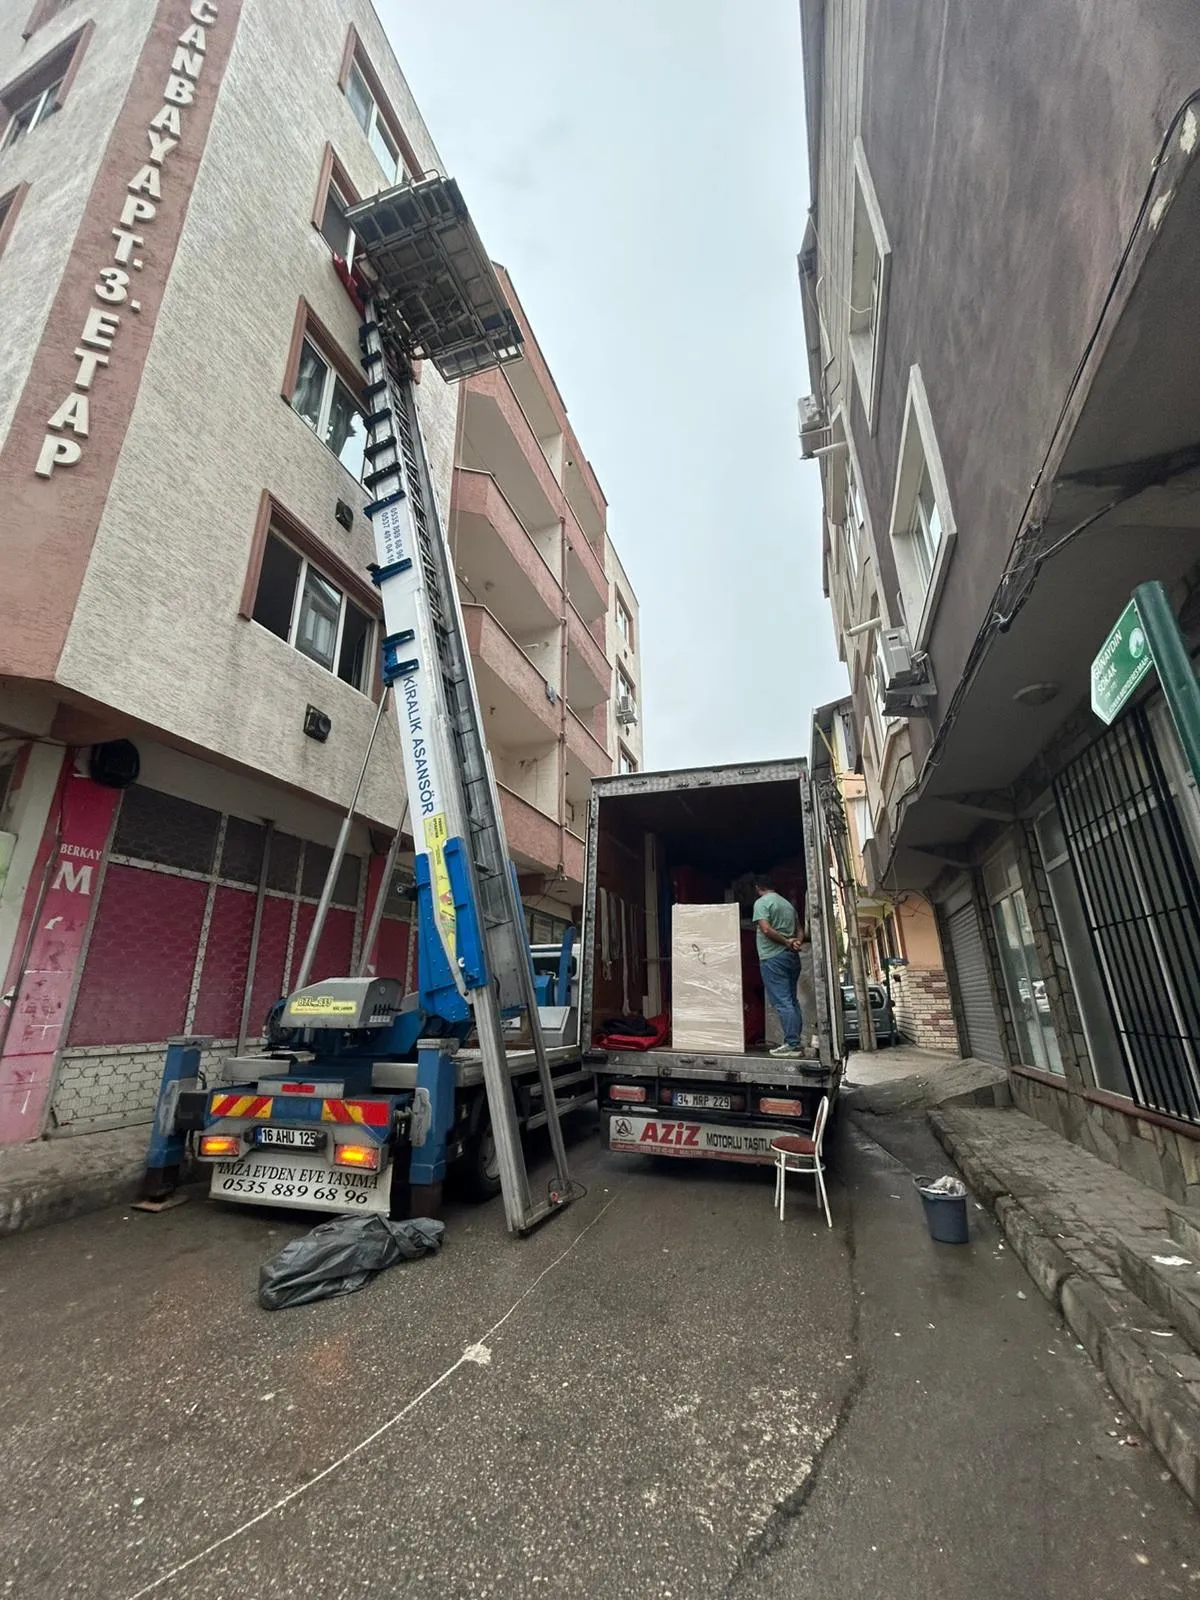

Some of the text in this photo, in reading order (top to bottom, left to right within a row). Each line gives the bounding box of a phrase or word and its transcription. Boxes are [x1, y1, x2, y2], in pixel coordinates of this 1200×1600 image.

[34, 307, 120, 479] ETAP
[403, 674, 436, 816] KİRALIK ASANSÖR
[60, 843, 102, 860] BERKAY
[677, 1094, 689, 1105] 34
[262, 1129, 316, 1146] 16 AHU 125
[706, 1132, 742, 1150] MOTORLU
[252, 1165, 296, 1182] EVDEN
[298, 1169, 325, 1183] EVE
[327, 1171, 379, 1190] TAŞIMA
[222, 1178, 370, 1205] 0535 889 68 96
